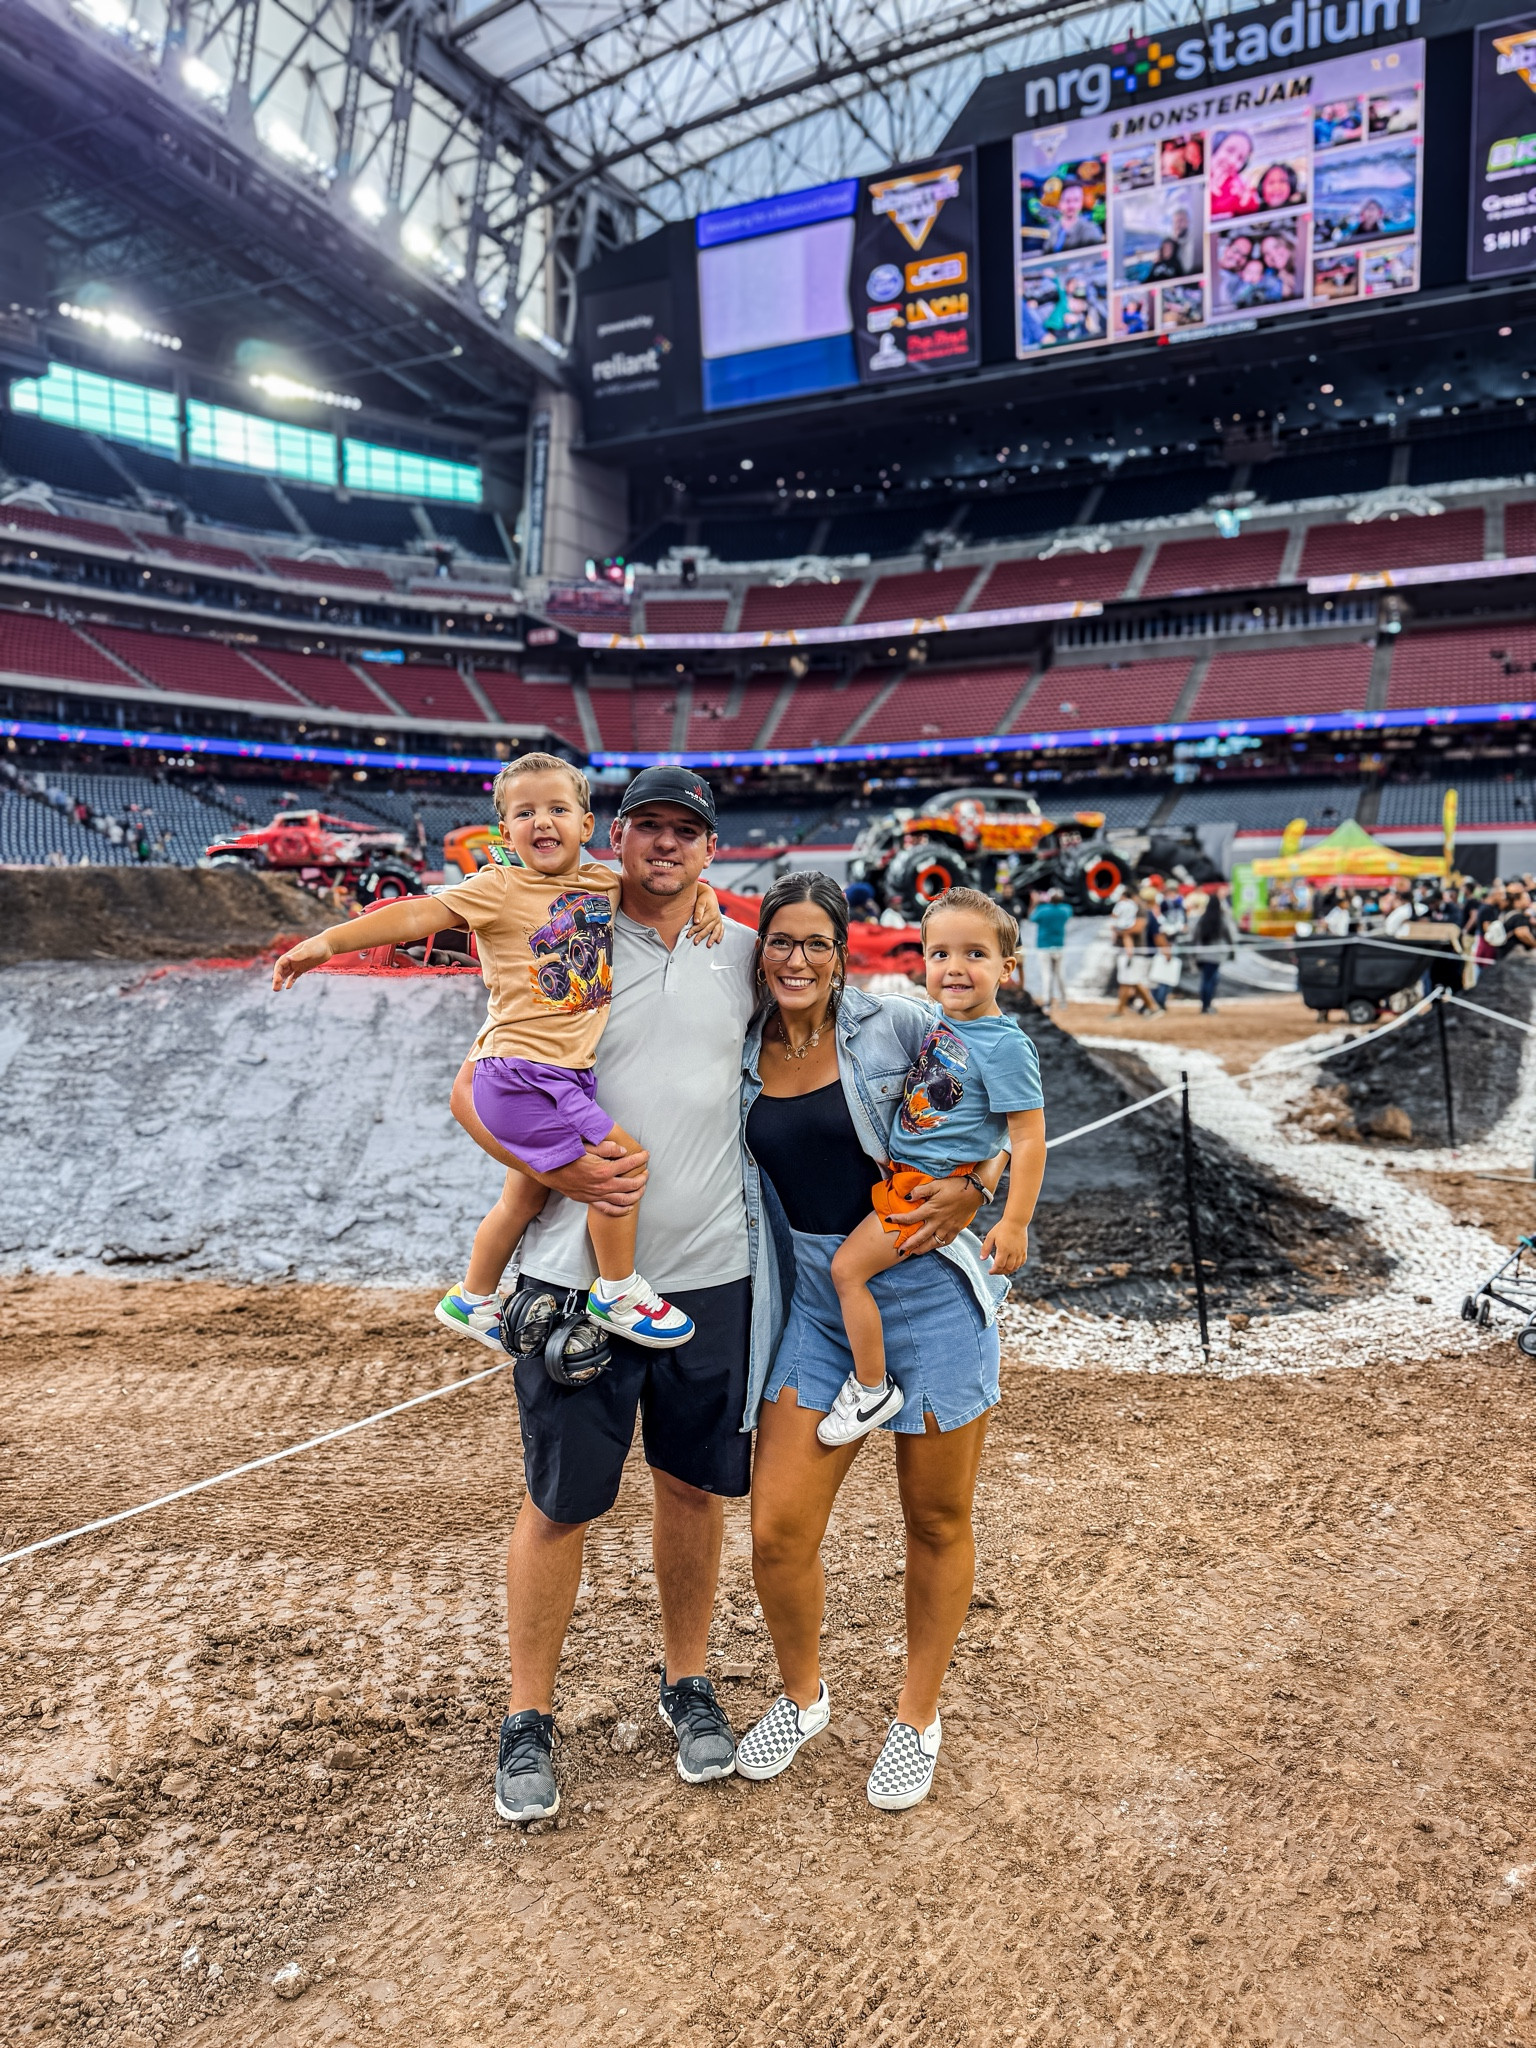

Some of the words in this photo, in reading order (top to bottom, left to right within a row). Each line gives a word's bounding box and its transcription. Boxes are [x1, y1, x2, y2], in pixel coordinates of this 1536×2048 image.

[1025, 63, 1111, 118] nrg
[1174, 0, 1420, 81] stadium
[1110, 76, 1313, 139] #MONSTERJAM
[592, 347, 660, 381] reliant
